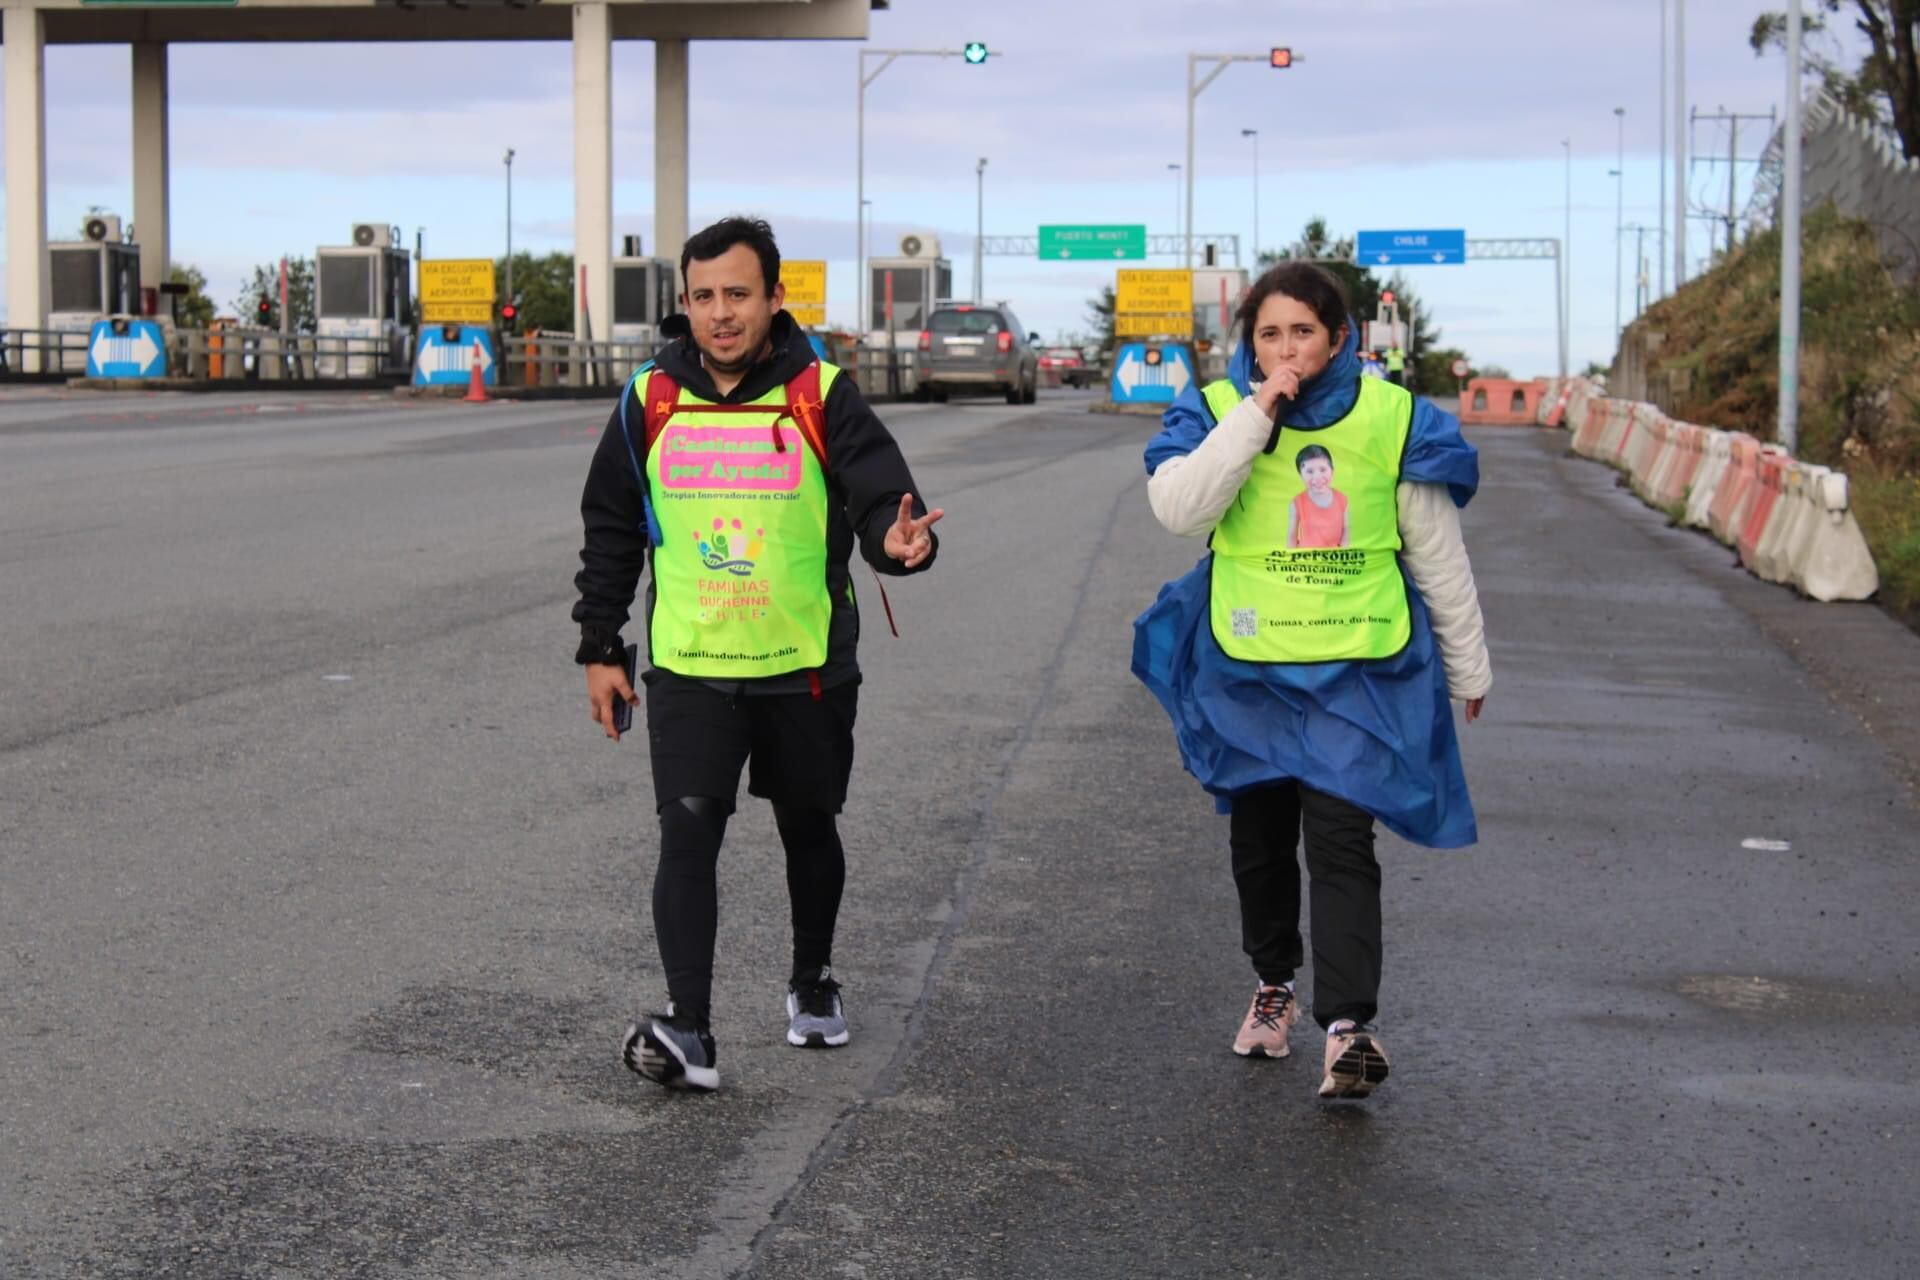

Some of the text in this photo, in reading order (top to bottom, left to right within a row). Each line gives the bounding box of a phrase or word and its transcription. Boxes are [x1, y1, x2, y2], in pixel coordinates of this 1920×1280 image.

[1054, 231, 1129, 240] PUERTO MONTT
[441, 264, 489, 273] EXCLUSIVA
[1140, 272, 1188, 282] EXCLUSIVA
[430, 287, 486, 297] AEROPUERTO
[1127, 299, 1183, 309] AEROPUERTO
[669, 464, 704, 481] por
[698, 491, 757, 500] Innovadoras
[760, 493, 772, 501] en
[1289, 550, 1366, 563] personas
[1285, 574, 1301, 584] de
[697, 579, 770, 595] FAMILIAS
[699, 595, 771, 609] DUCHENNE
